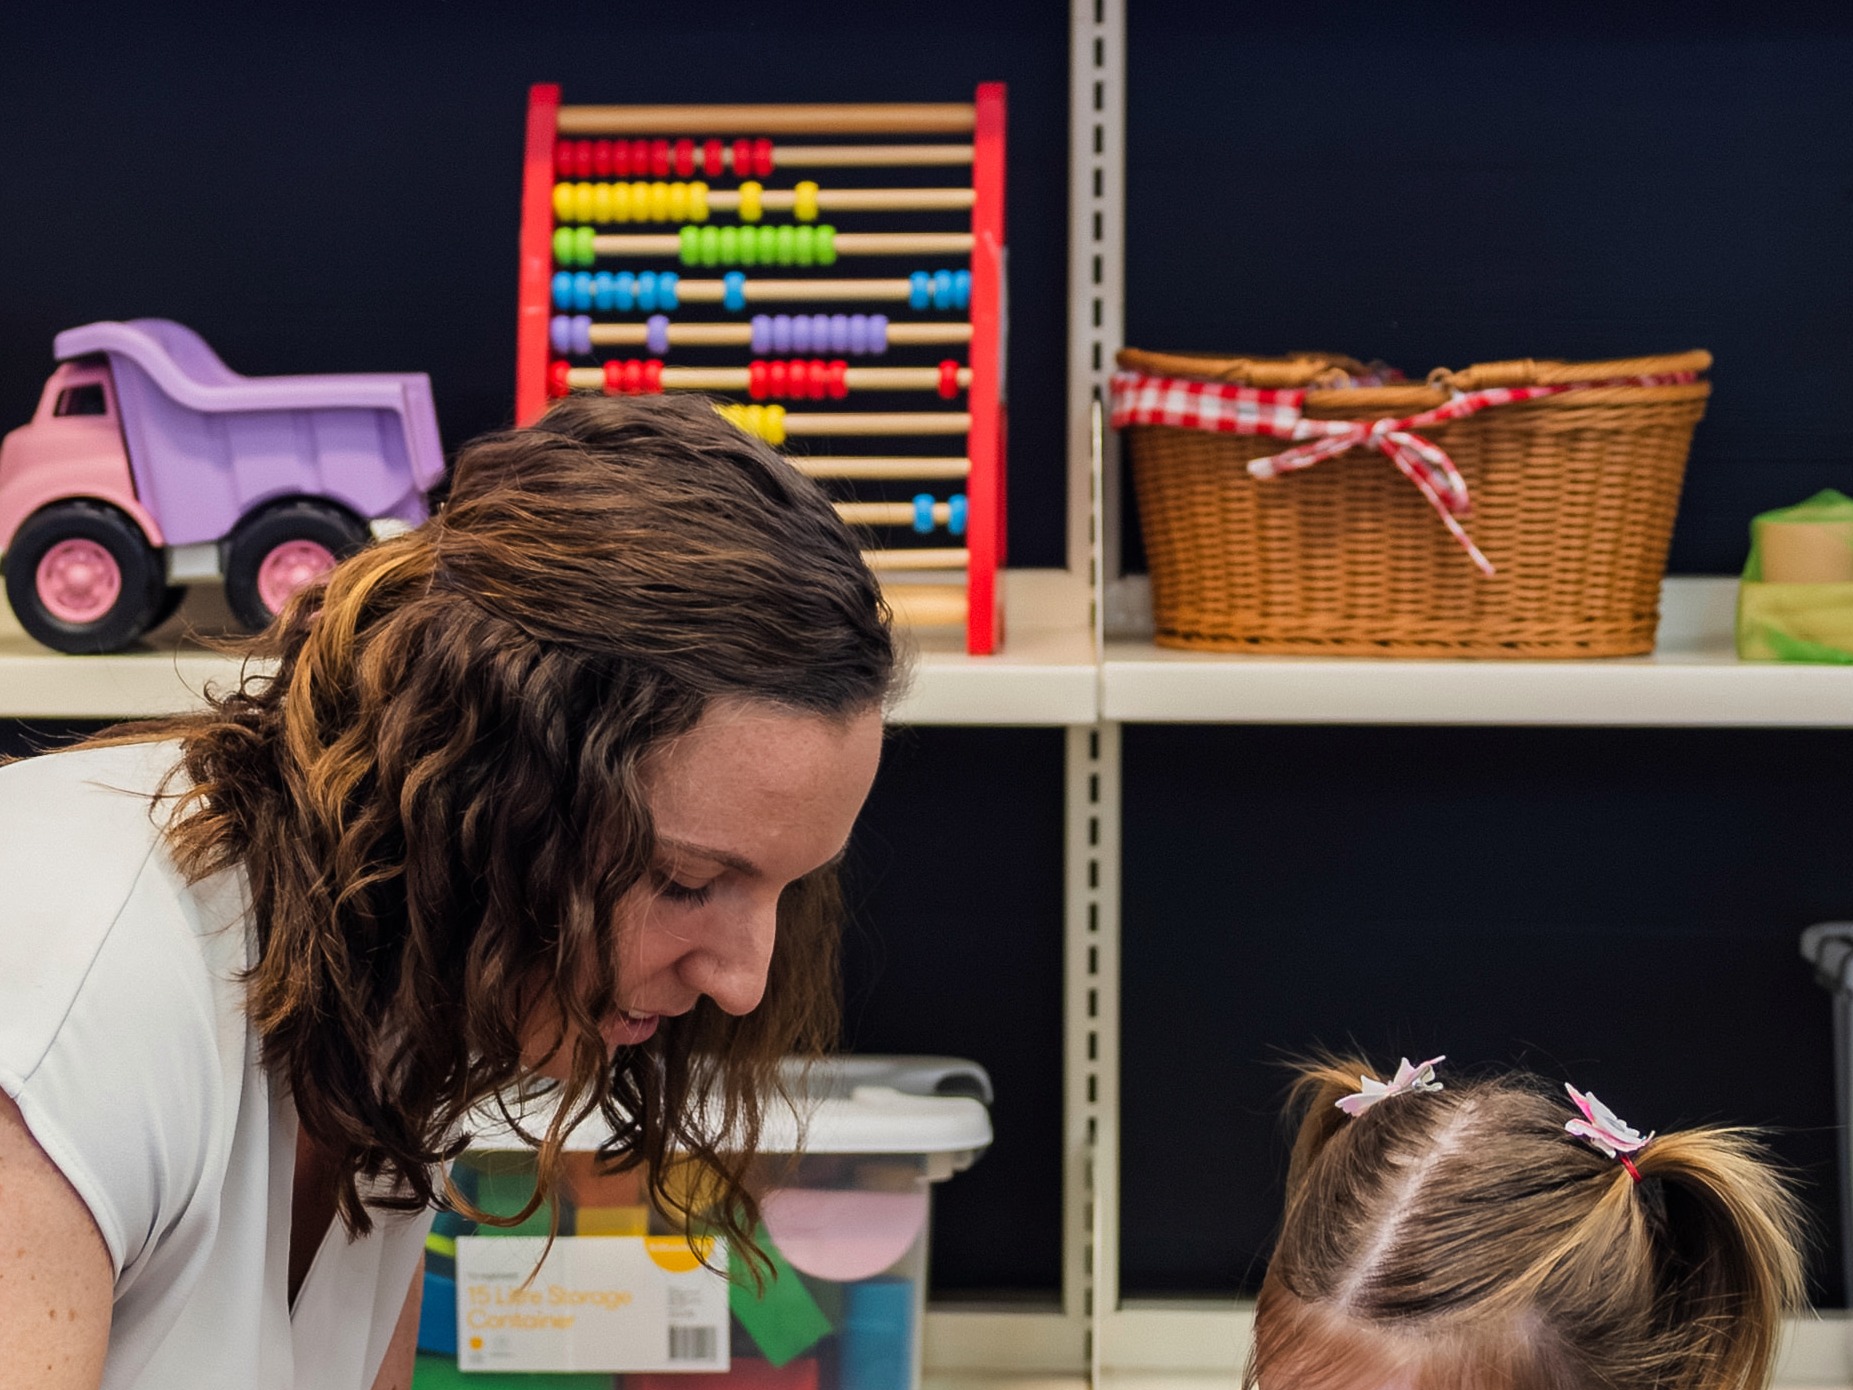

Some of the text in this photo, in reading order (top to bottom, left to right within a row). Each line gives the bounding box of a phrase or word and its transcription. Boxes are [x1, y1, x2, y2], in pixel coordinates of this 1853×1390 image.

[468, 1284, 490, 1306] 15
[548, 1283, 633, 1311] Storage
[467, 1308, 576, 1329] Container
